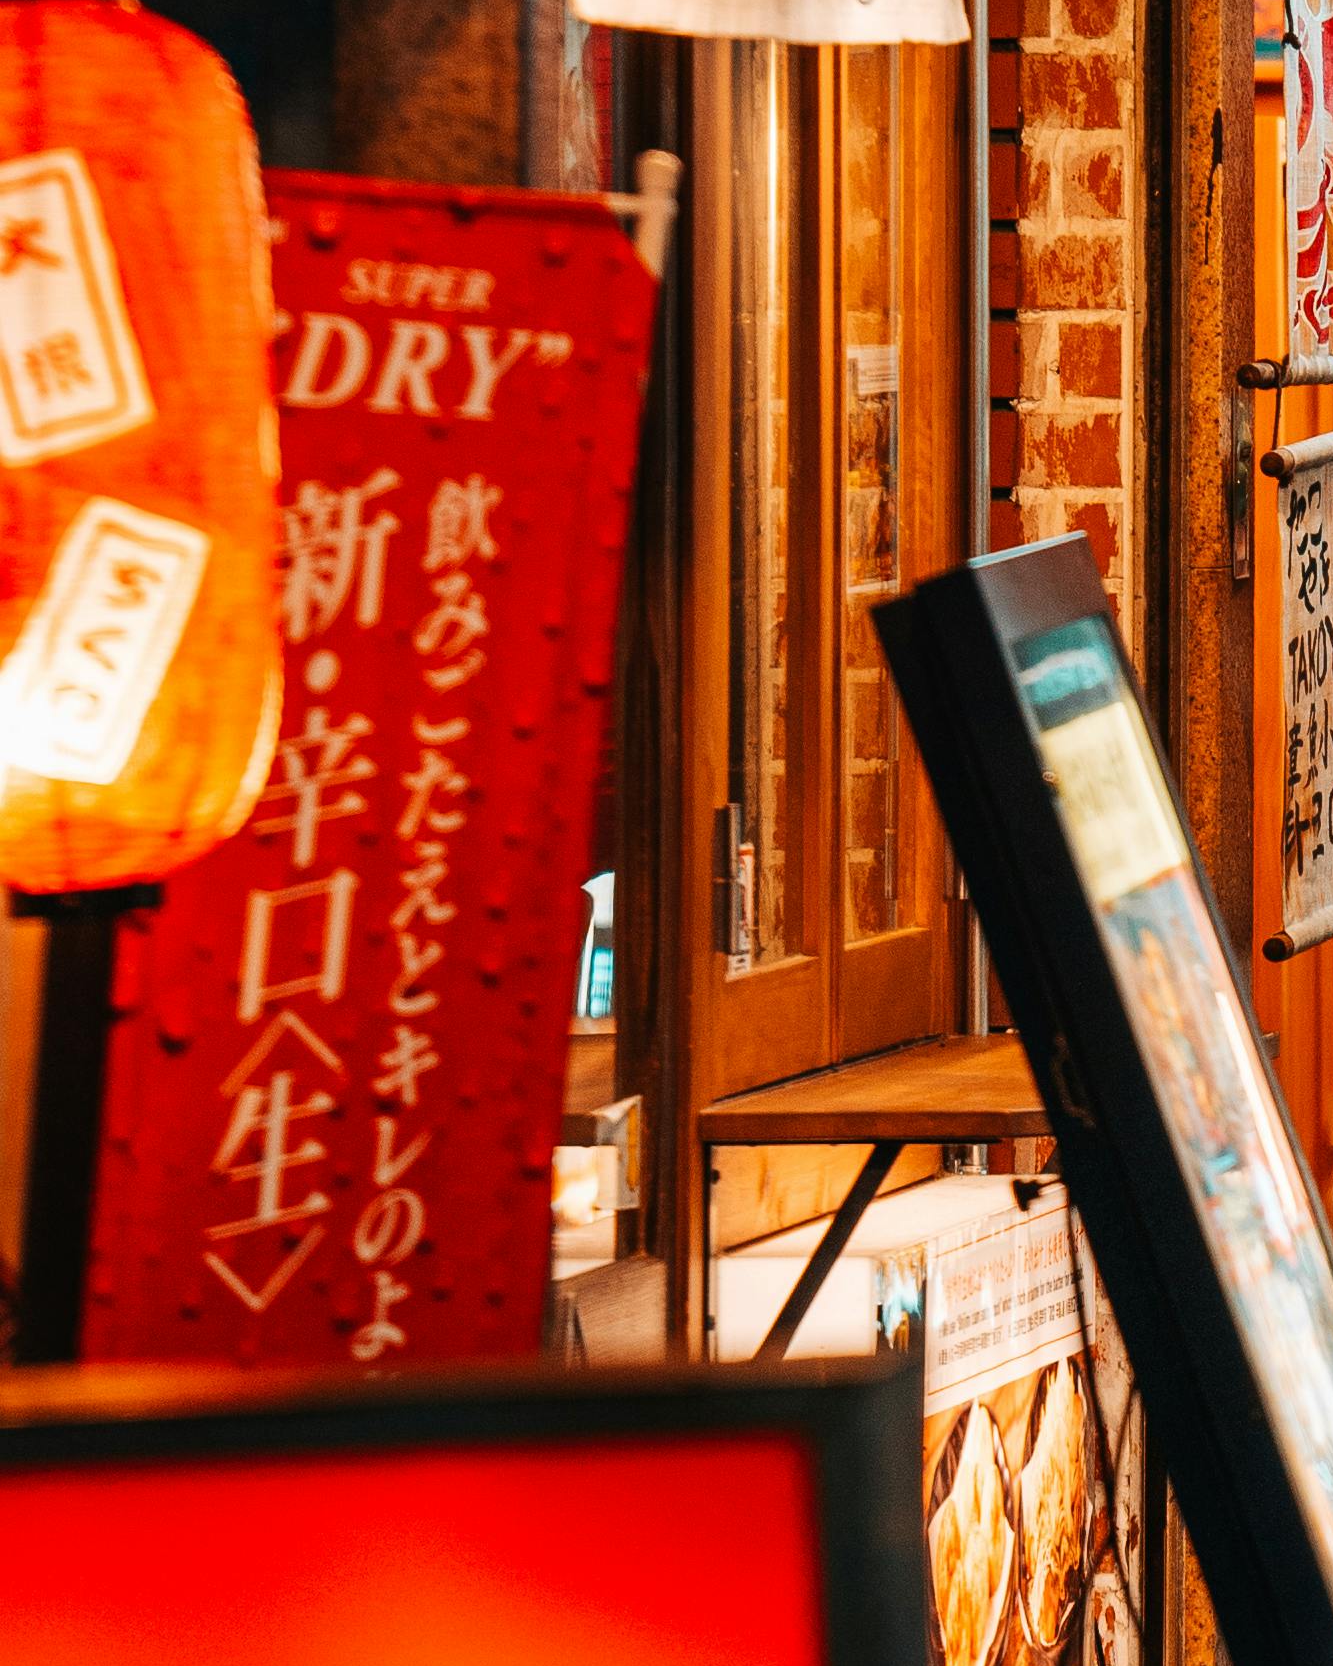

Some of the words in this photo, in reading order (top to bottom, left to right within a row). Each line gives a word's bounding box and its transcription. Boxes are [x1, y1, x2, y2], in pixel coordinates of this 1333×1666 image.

[338, 258, 498, 314] SUPER
[348, 471, 508, 1379] 飲みごたえとキレのよ
